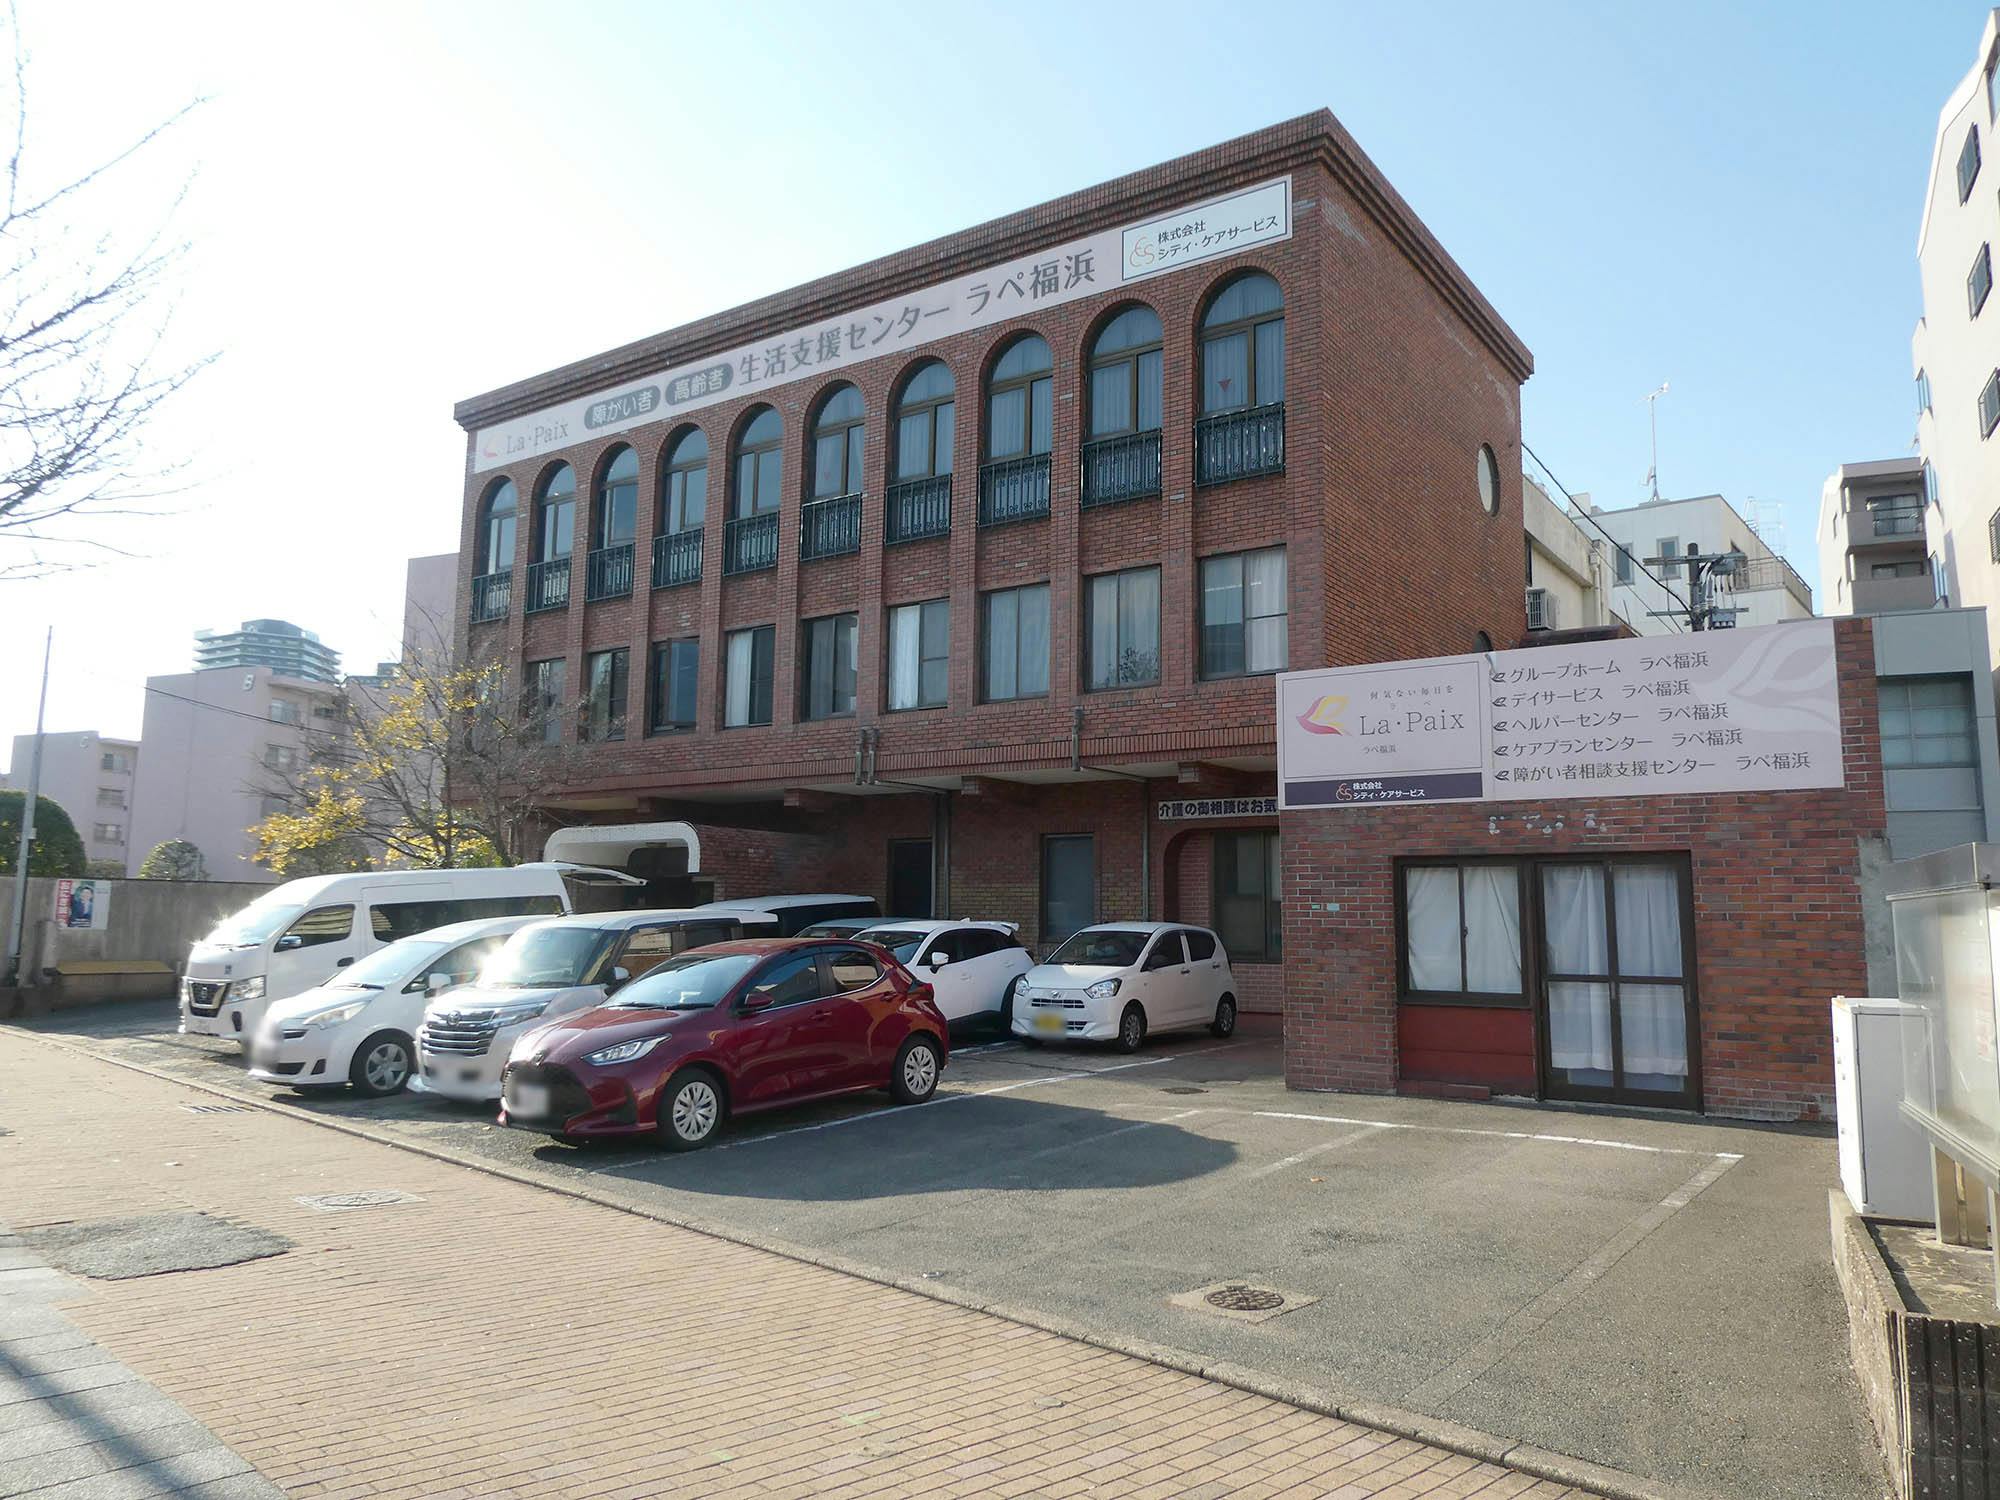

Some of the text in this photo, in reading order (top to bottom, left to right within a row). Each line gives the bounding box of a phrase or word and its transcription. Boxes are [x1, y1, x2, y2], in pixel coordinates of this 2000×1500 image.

[1158, 220, 1206, 244] 株式会社
[1158, 215, 1279, 261] シティ・ケアサービス
[592, 249, 1095, 425] 障がい者 高齢者 生活支援センター ラペ福浜
[1510, 651, 1709, 684] グループホーム ラペ福浜
[1511, 679, 1691, 708] デイサービス ラペ福浜
[1512, 702, 1729, 731] ヘルパーセンター ラペ福浜
[1513, 728, 1744, 757] ケアプランセンター ラペ福浜
[1513, 752, 1811, 782] 障がい者相談支援センター ラペ福浜
[1352, 781, 1383, 790] 株式会社
[1353, 789, 1425, 800] シティ・ケアサービス
